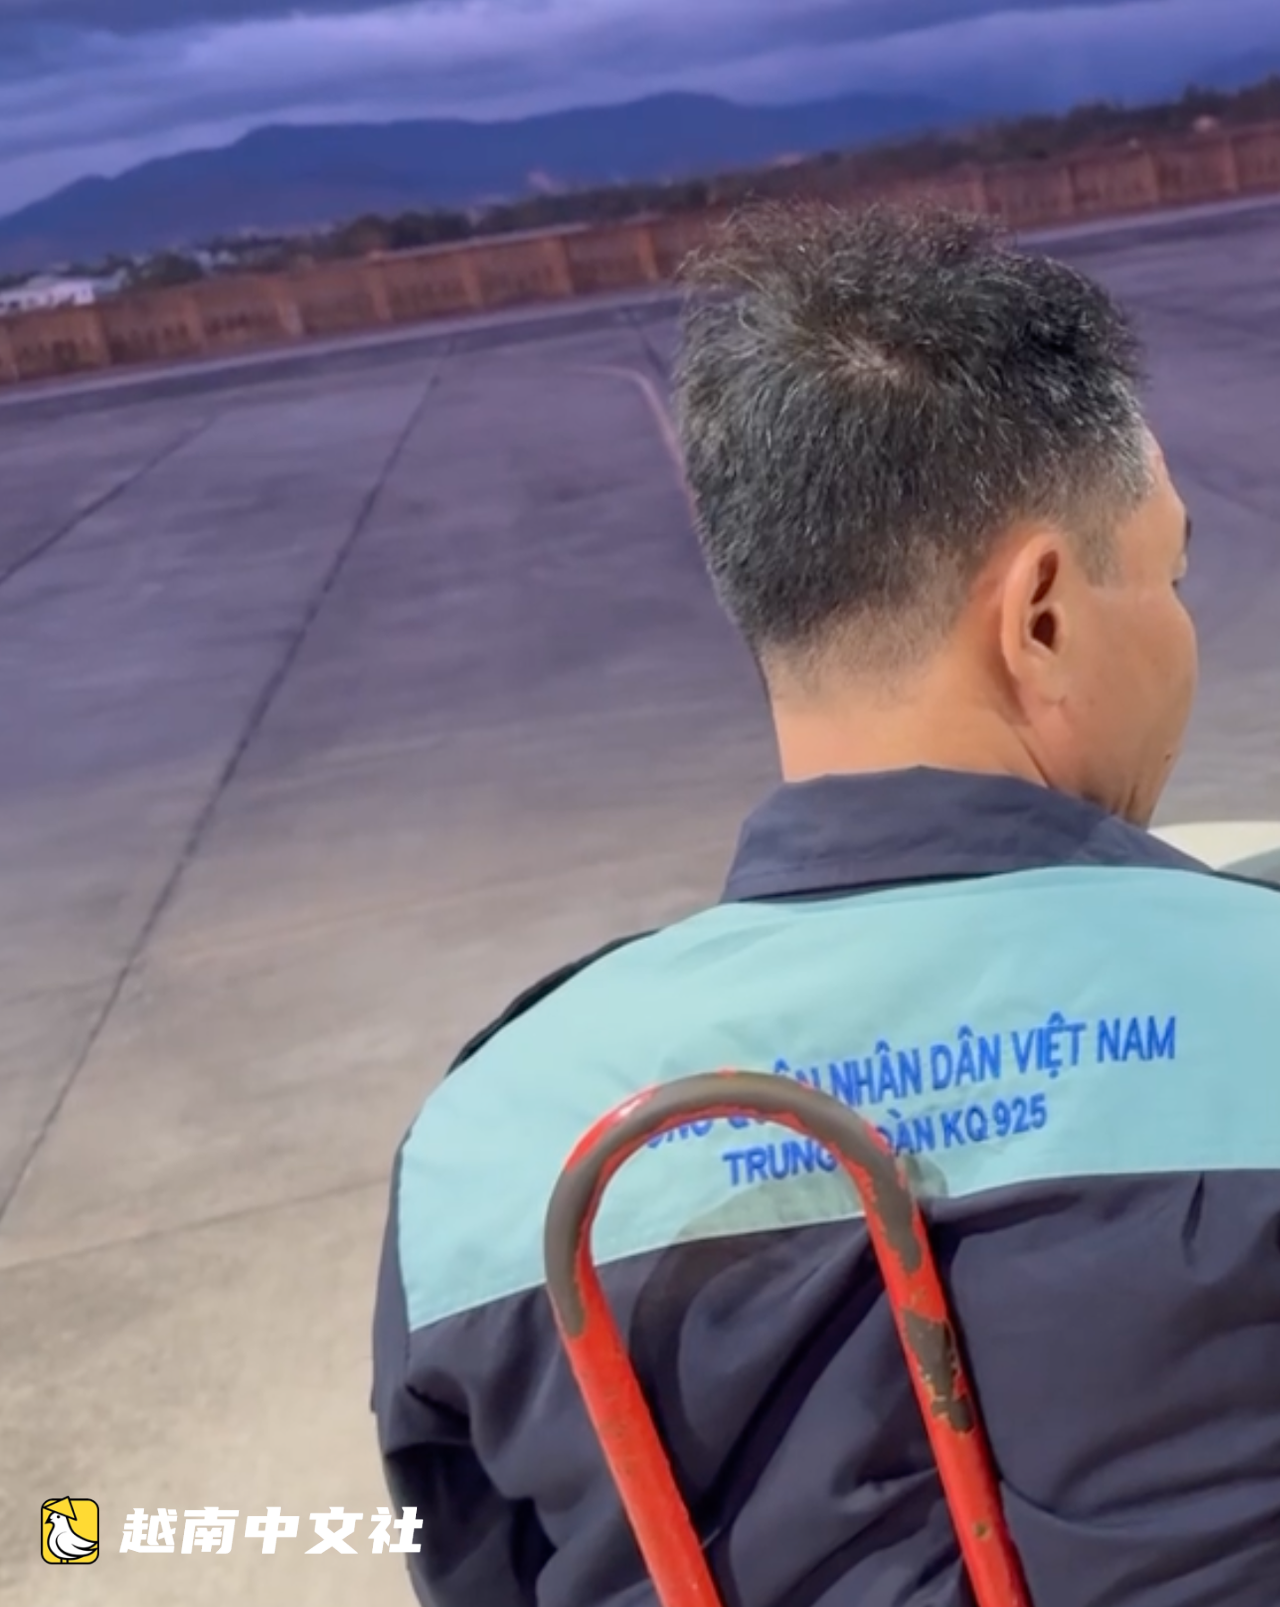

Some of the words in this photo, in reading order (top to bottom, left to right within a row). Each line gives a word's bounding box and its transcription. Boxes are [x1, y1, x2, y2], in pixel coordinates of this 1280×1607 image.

[829, 1039, 923, 1107] NHÂN
[930, 1024, 1002, 1091] DÂN
[1010, 1011, 1088, 1080] VIỆT
[1096, 1015, 1177, 1065] NAM
[940, 1103, 989, 1149] KQ
[992, 1092, 1047, 1138] 925
